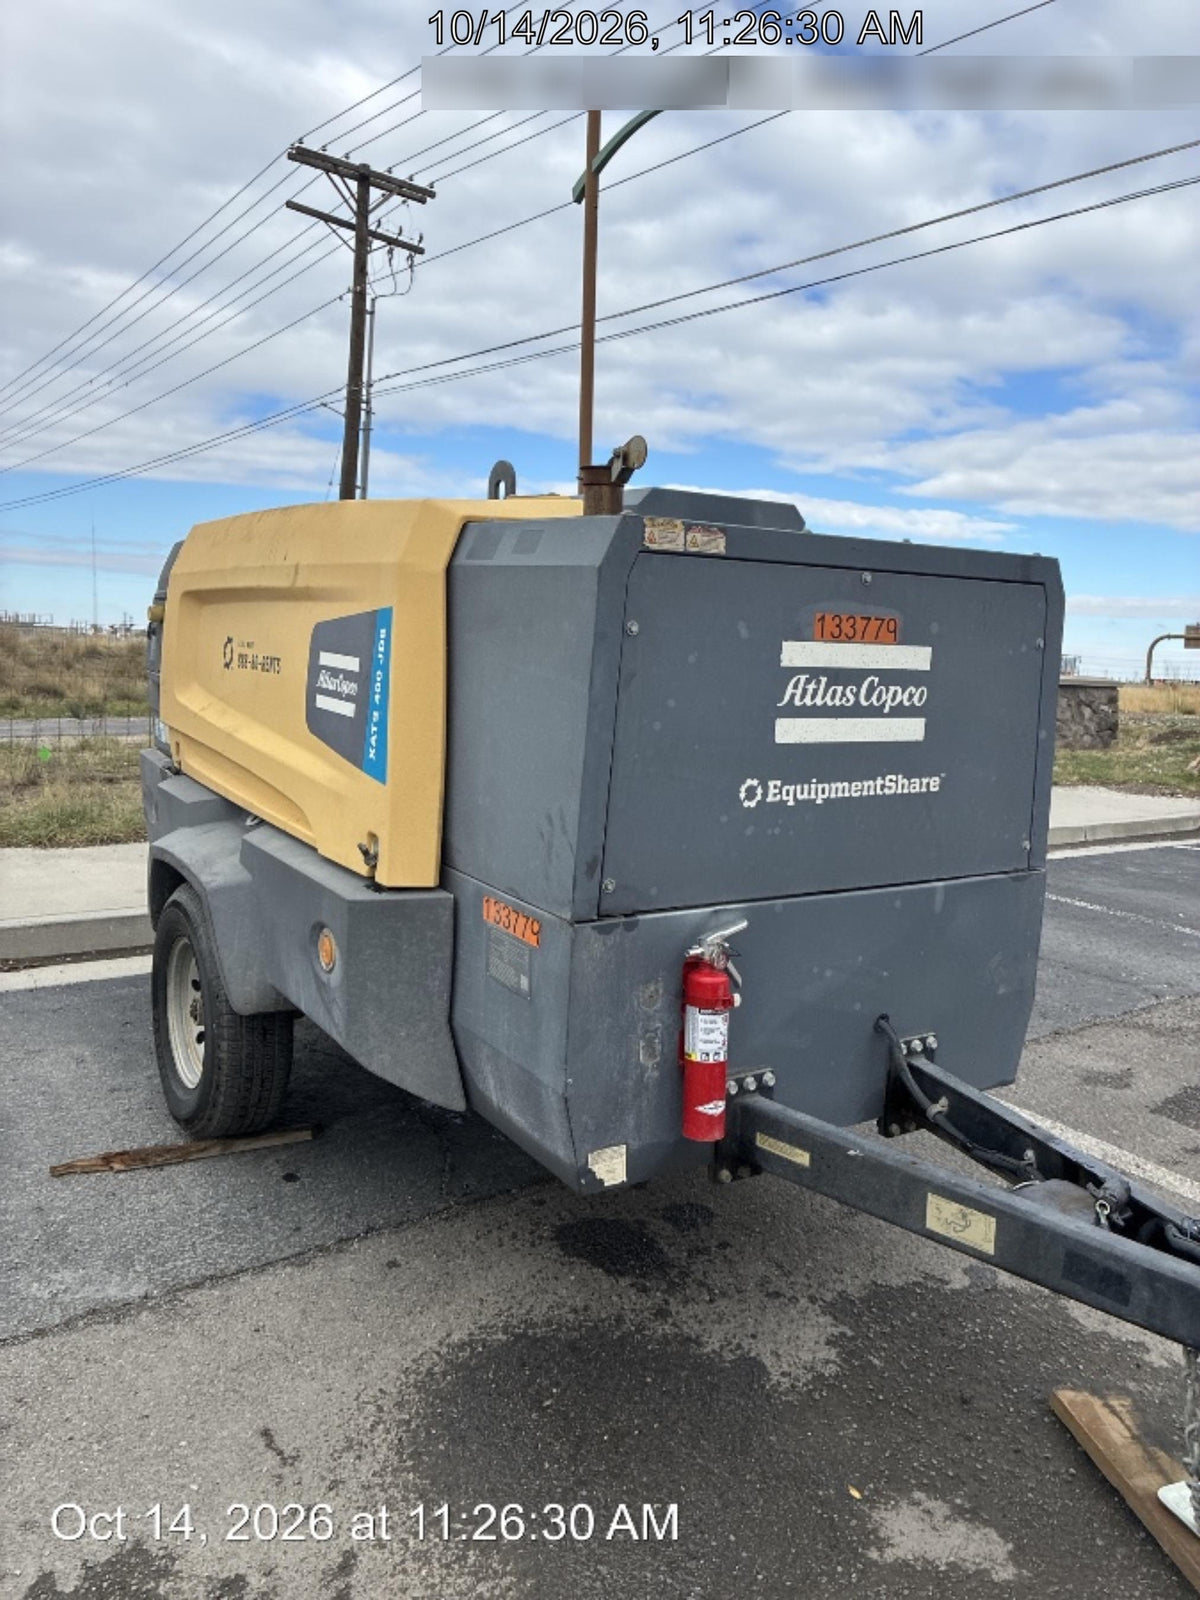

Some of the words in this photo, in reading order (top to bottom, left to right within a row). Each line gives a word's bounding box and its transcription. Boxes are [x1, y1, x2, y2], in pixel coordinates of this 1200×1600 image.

[816, 614, 898, 642] 133779
[374, 669, 384, 705] 400
[777, 674, 856, 706] Atlas
[860, 675, 927, 713] Copco
[766, 774, 941, 804] EquipmentShare
[484, 898, 541, 946] 133779
